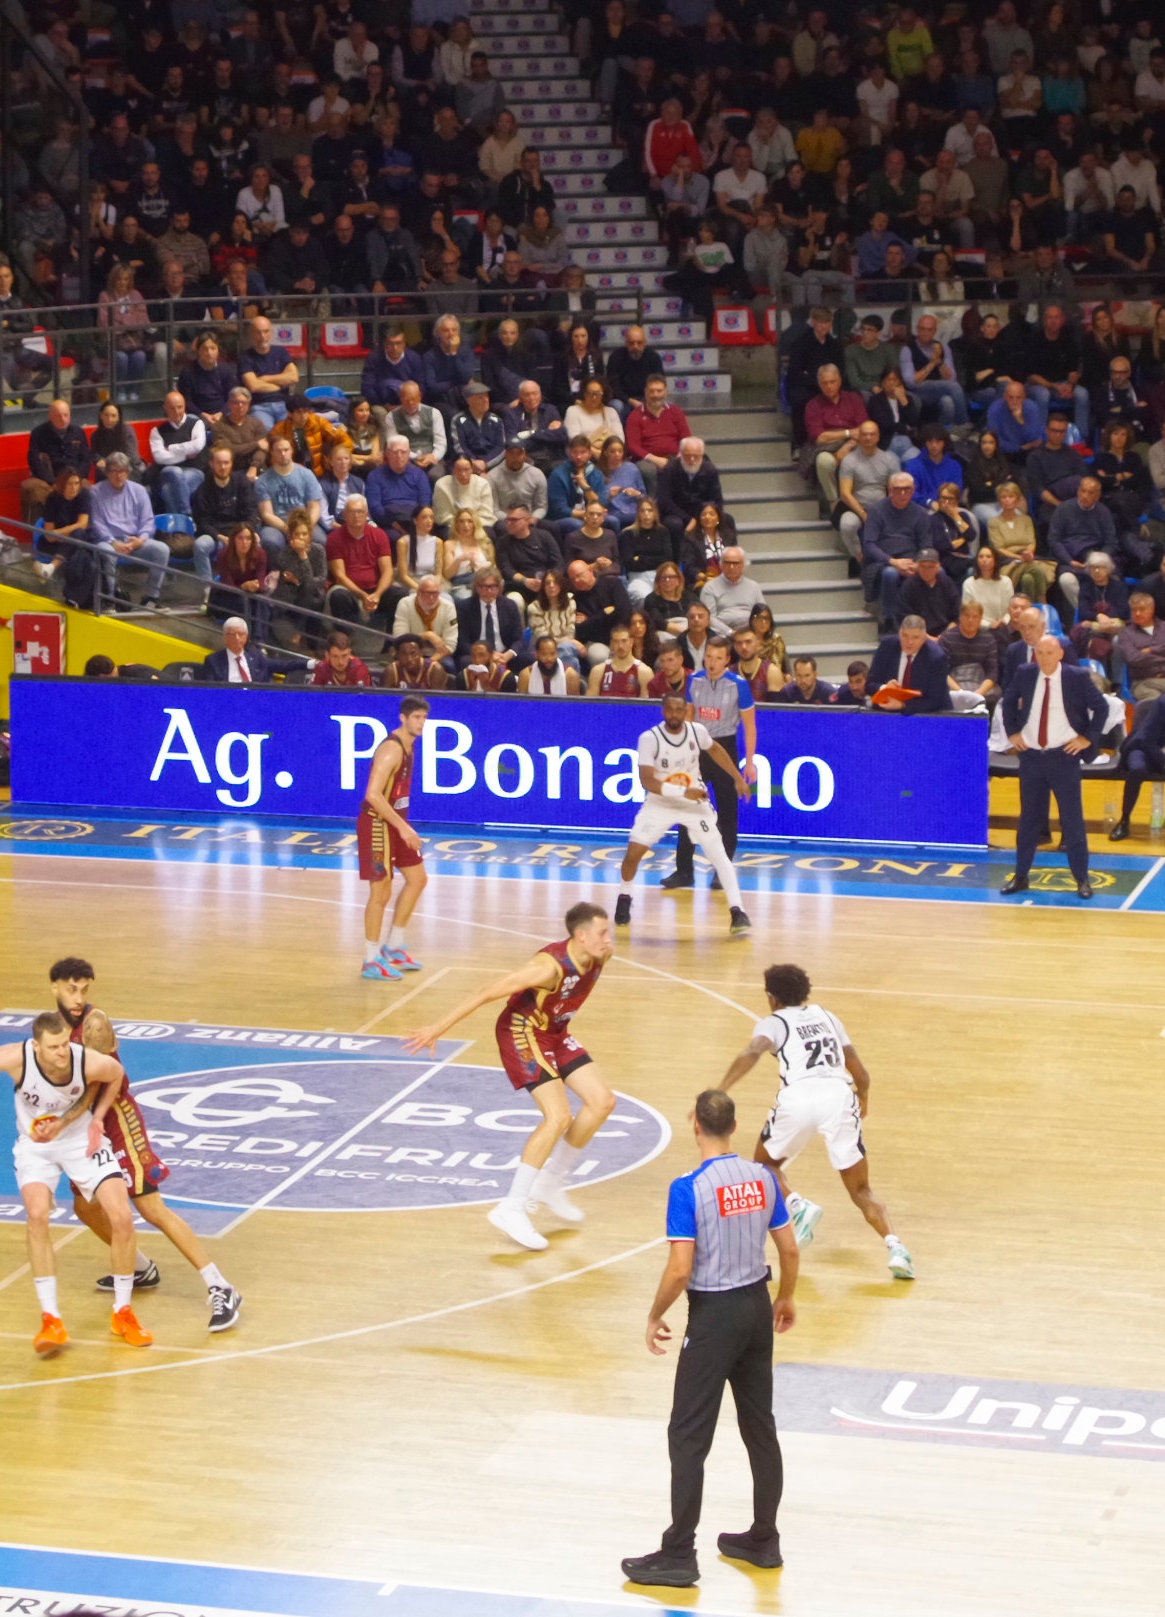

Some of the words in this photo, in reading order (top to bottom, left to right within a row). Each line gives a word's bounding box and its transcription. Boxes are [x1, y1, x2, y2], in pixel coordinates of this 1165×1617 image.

[150, 707, 294, 808] Ag.
[699, 820, 709, 833] 8
[122, 824, 498, 854] ITALIO
[311, 847, 548, 866] GILLERIE
[184, 1027, 382, 1052] Allianz
[805, 1037, 840, 1071] 23
[381, 1101, 644, 1138] BCC
[92, 1148, 115, 1168] 22
[142, 1129, 324, 1158] REDI
[335, 1143, 601, 1177] FRIUI
[161, 1157, 291, 1174] GRUPPO
[315, 1168, 379, 1181] BCC
[385, 1172, 500, 1189] ICCREA
[722, 1180, 763, 1202] ATTAL
[723, 1195, 764, 1212] GROUP
